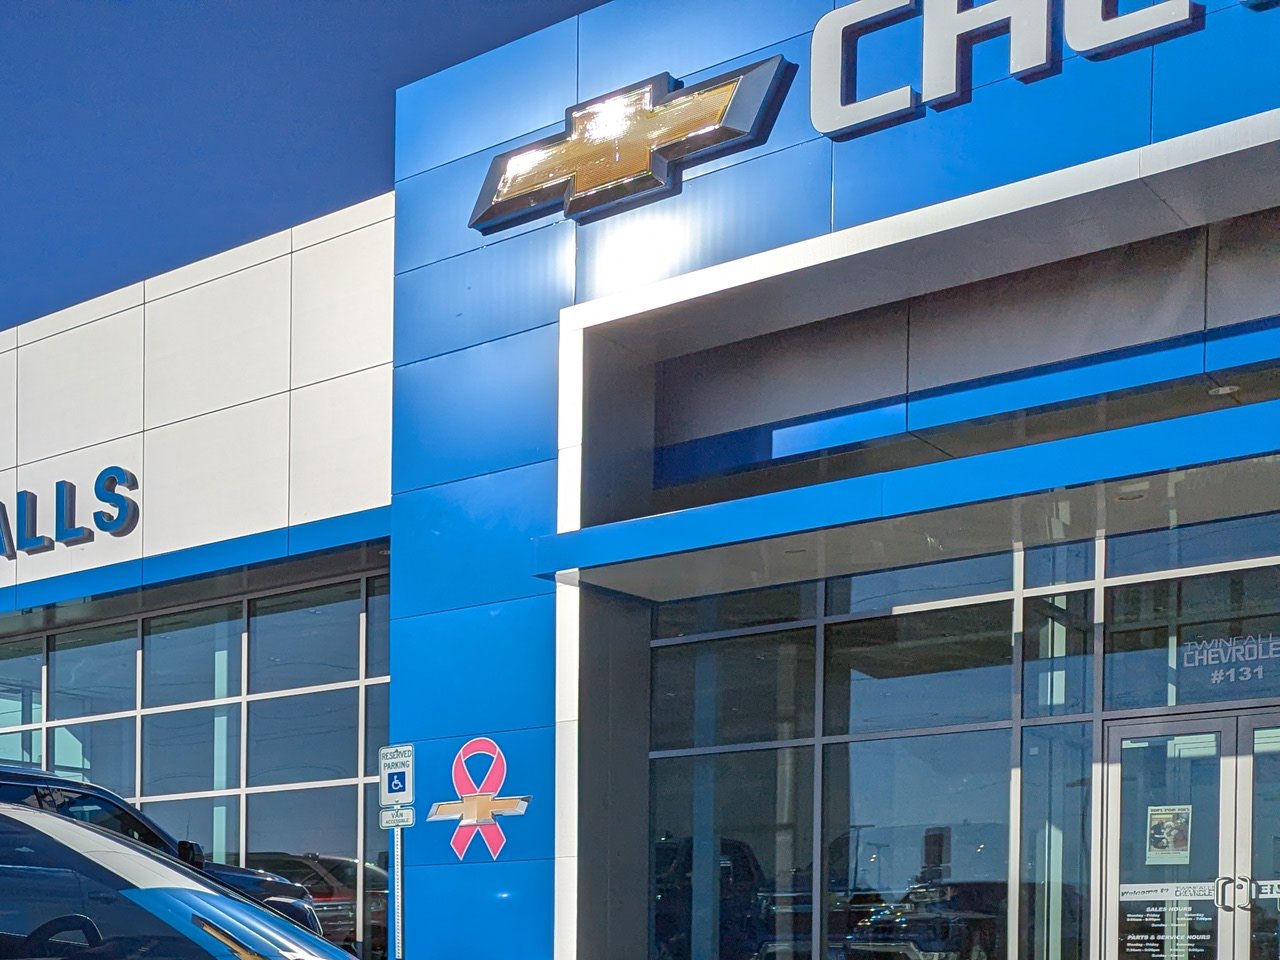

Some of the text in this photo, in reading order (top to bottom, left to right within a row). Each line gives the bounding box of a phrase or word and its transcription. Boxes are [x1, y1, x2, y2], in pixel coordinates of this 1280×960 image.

[1210, 665, 1264, 684] #131
[381, 749, 412, 760] RESERVED
[383, 760, 410, 770] PARKING
